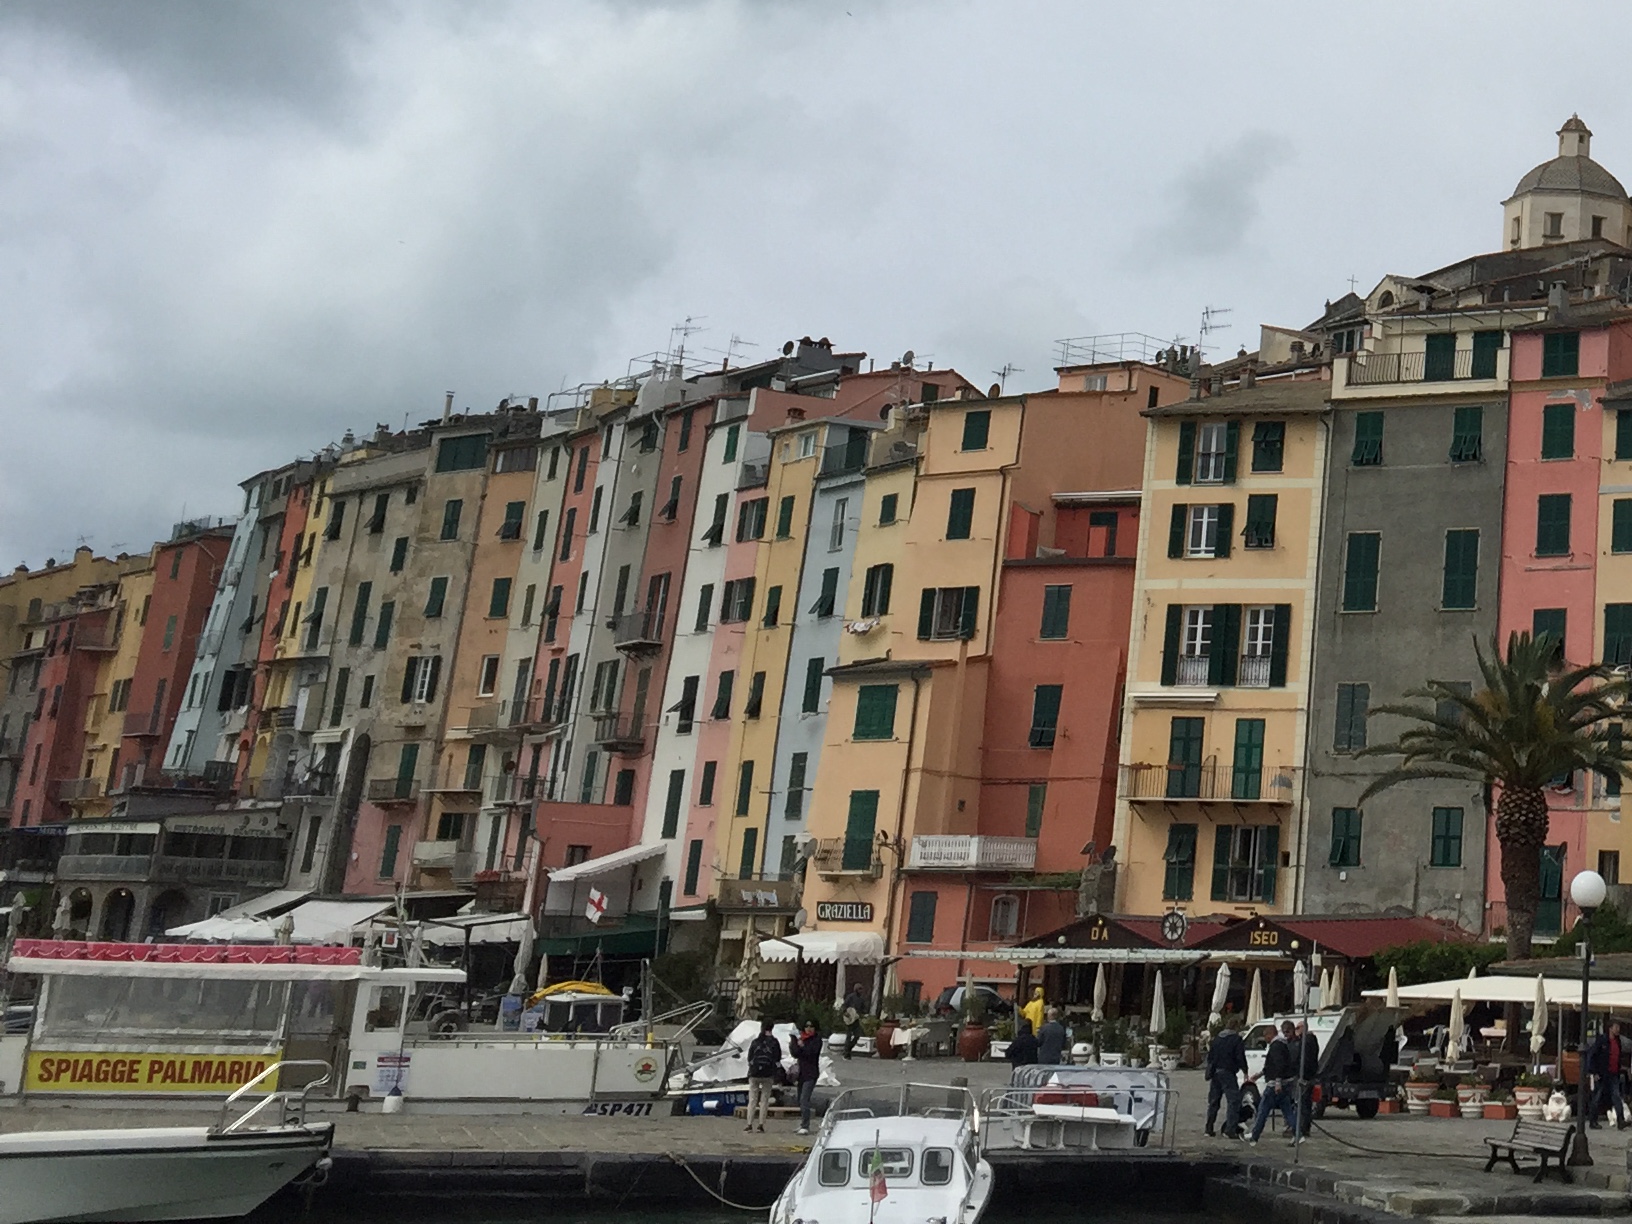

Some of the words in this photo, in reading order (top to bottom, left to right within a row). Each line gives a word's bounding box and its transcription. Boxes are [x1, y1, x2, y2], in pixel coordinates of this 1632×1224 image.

[818, 903, 871, 920] GRAZIELLA
[1250, 931, 1278, 945] ISEO
[38, 1058, 142, 1083] SPIAGGE
[147, 1060, 266, 1084] PALMARIA
